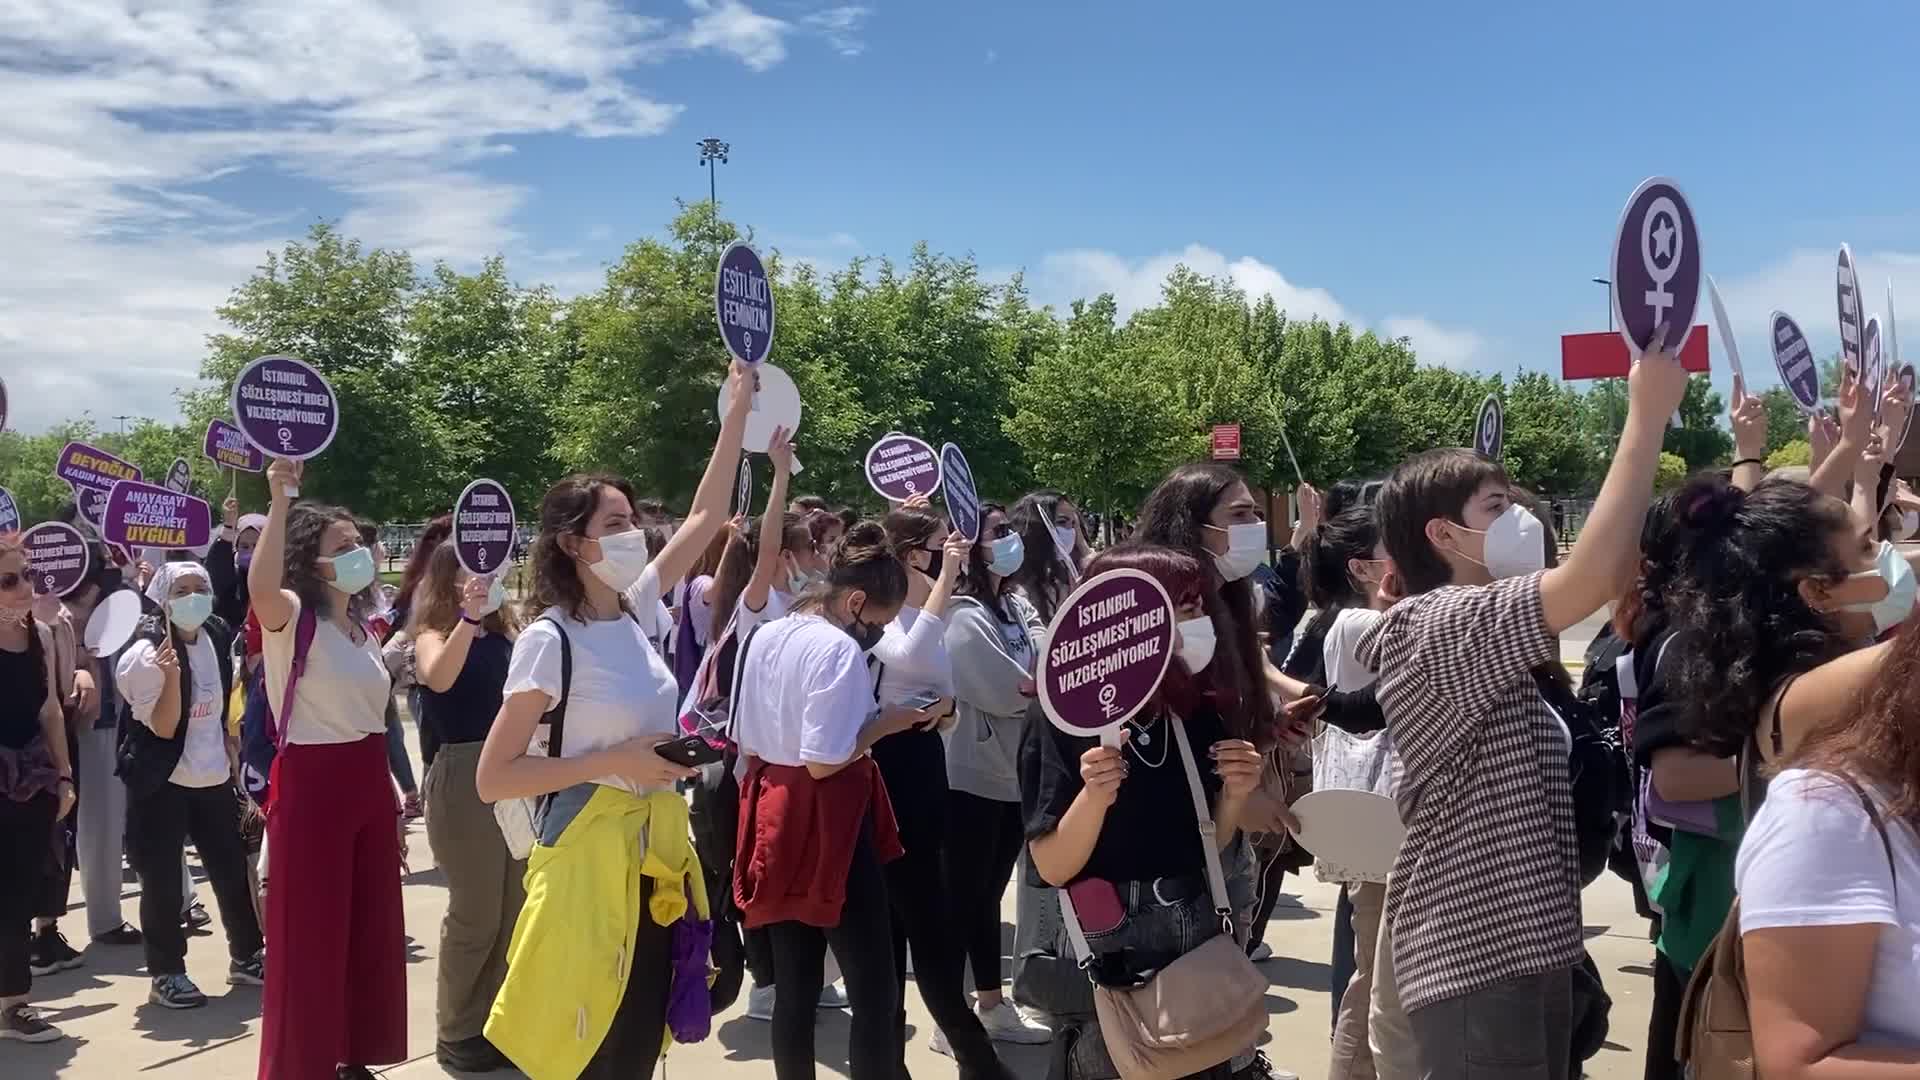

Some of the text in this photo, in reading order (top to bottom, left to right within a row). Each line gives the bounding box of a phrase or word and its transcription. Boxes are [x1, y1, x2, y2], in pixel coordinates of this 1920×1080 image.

[724, 298, 768, 334] FEMİNİZM
[262, 366, 307, 386] İSTANBUL
[246, 405, 326, 425] VAZGEÇMİYORUZ
[127, 526, 186, 545] UYGULA
[1078, 589, 1138, 628] İSTANBUL
[1051, 606, 1165, 668] SÖZLEŞMESİ'NDEN
[1058, 636, 1160, 694] VAZGEÇMİYORUZ
